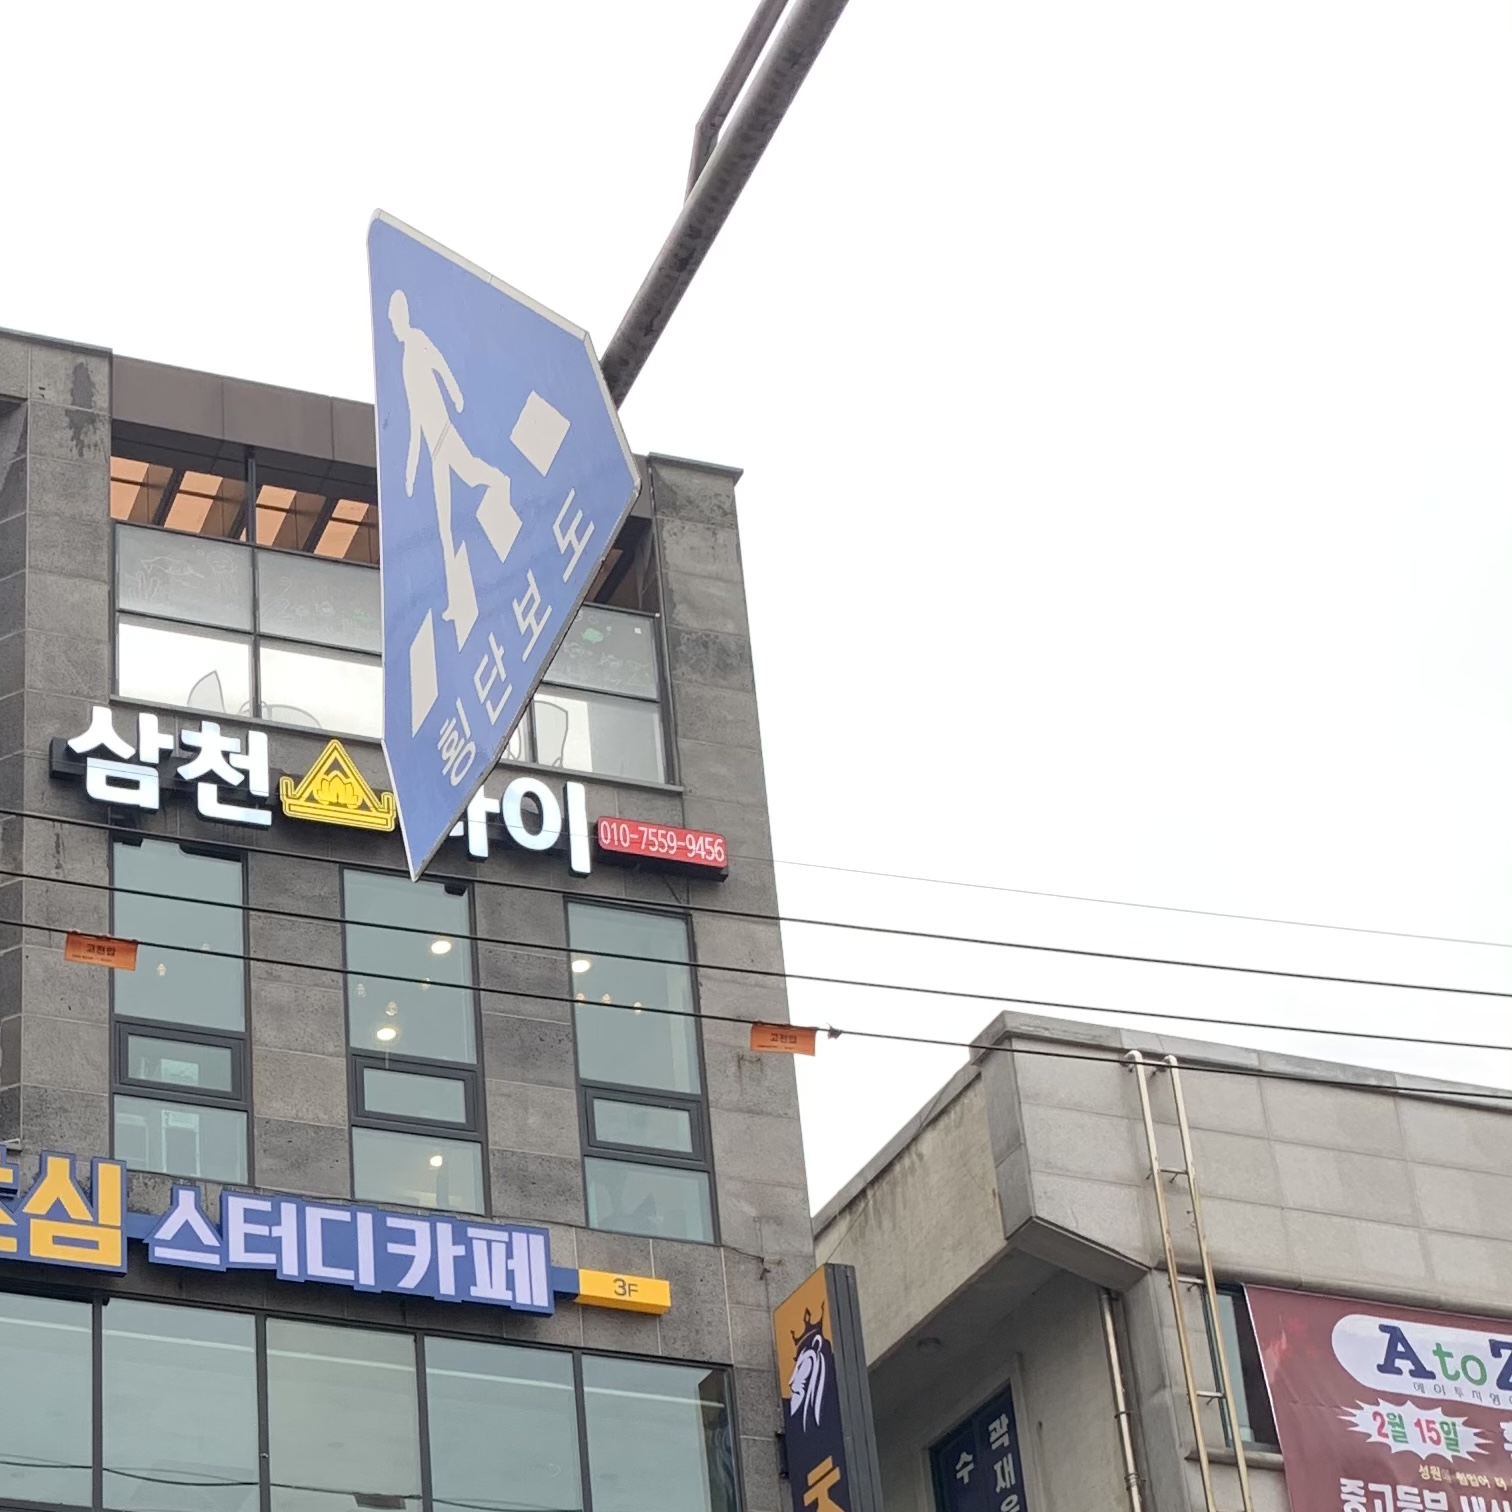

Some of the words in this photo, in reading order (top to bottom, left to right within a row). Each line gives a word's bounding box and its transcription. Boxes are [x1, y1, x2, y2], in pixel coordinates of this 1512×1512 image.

[438, 489, 596, 784] 횡단보도
[67, 705, 273, 828] 삼천
[598, 818, 726, 865] 010-7559-9456
[153, 1187, 550, 1306] 스터디카페
[613, 1277, 640, 1298] 3F
[1371, 1410, 1409, 1444] 2월
[1413, 1417, 1461, 1453] 15일
